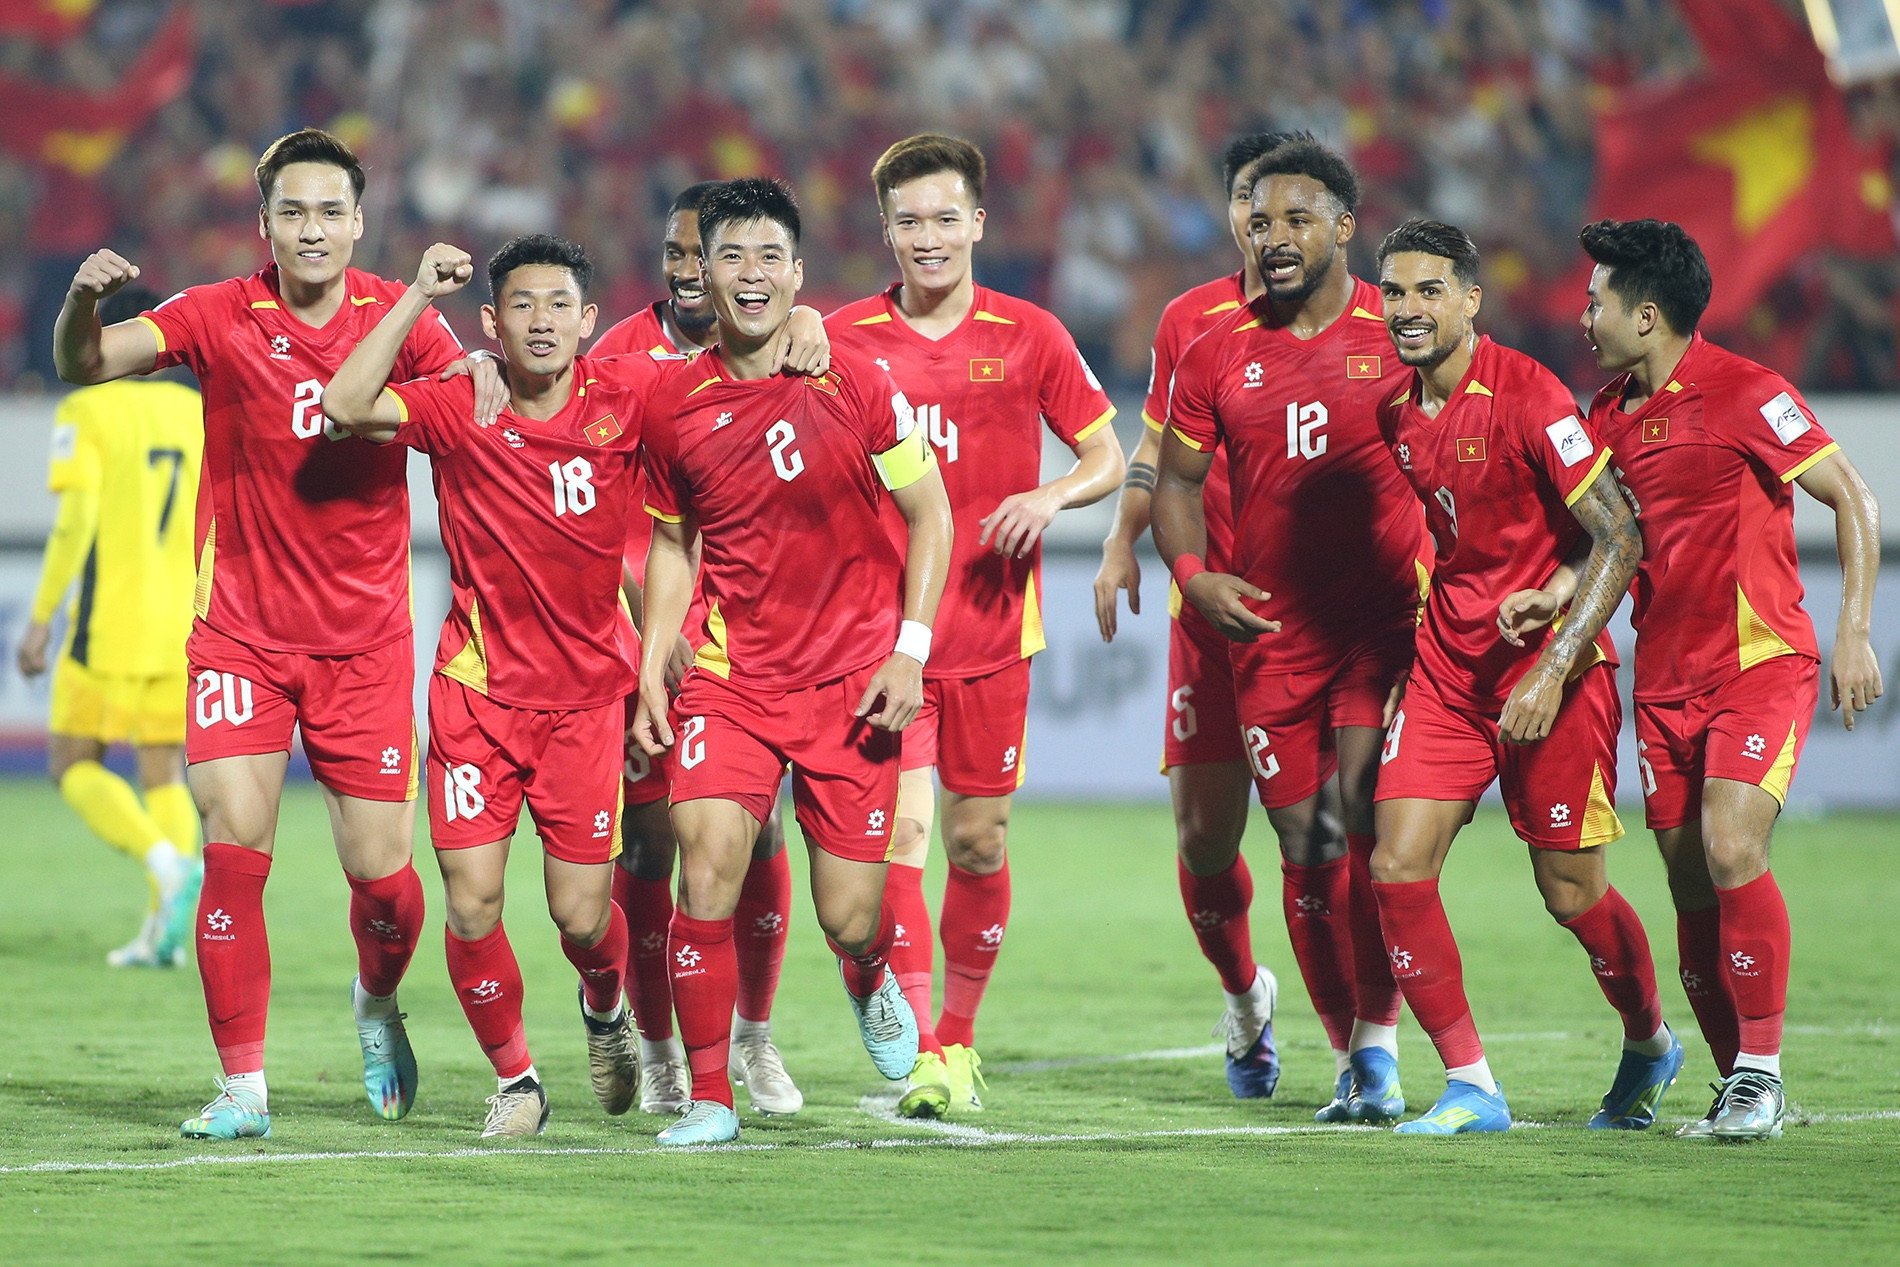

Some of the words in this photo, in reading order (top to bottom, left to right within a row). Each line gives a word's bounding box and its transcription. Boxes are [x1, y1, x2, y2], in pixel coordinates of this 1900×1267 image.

[291, 378, 352, 442] 2
[917, 404, 959, 463] 14
[1286, 401, 1328, 460] 12
[1777, 406, 1796, 428] AFC
[766, 419, 804, 482] 2
[1561, 430, 1582, 450] AFC
[148, 448, 184, 542] 7
[549, 455, 596, 518] 18
[1434, 486, 1458, 538] 9
[196, 669, 254, 729] 20
[1172, 684, 1198, 742] 5
[681, 715, 706, 770] 2
[1381, 709, 1406, 766] 9
[444, 762, 486, 822] 18
